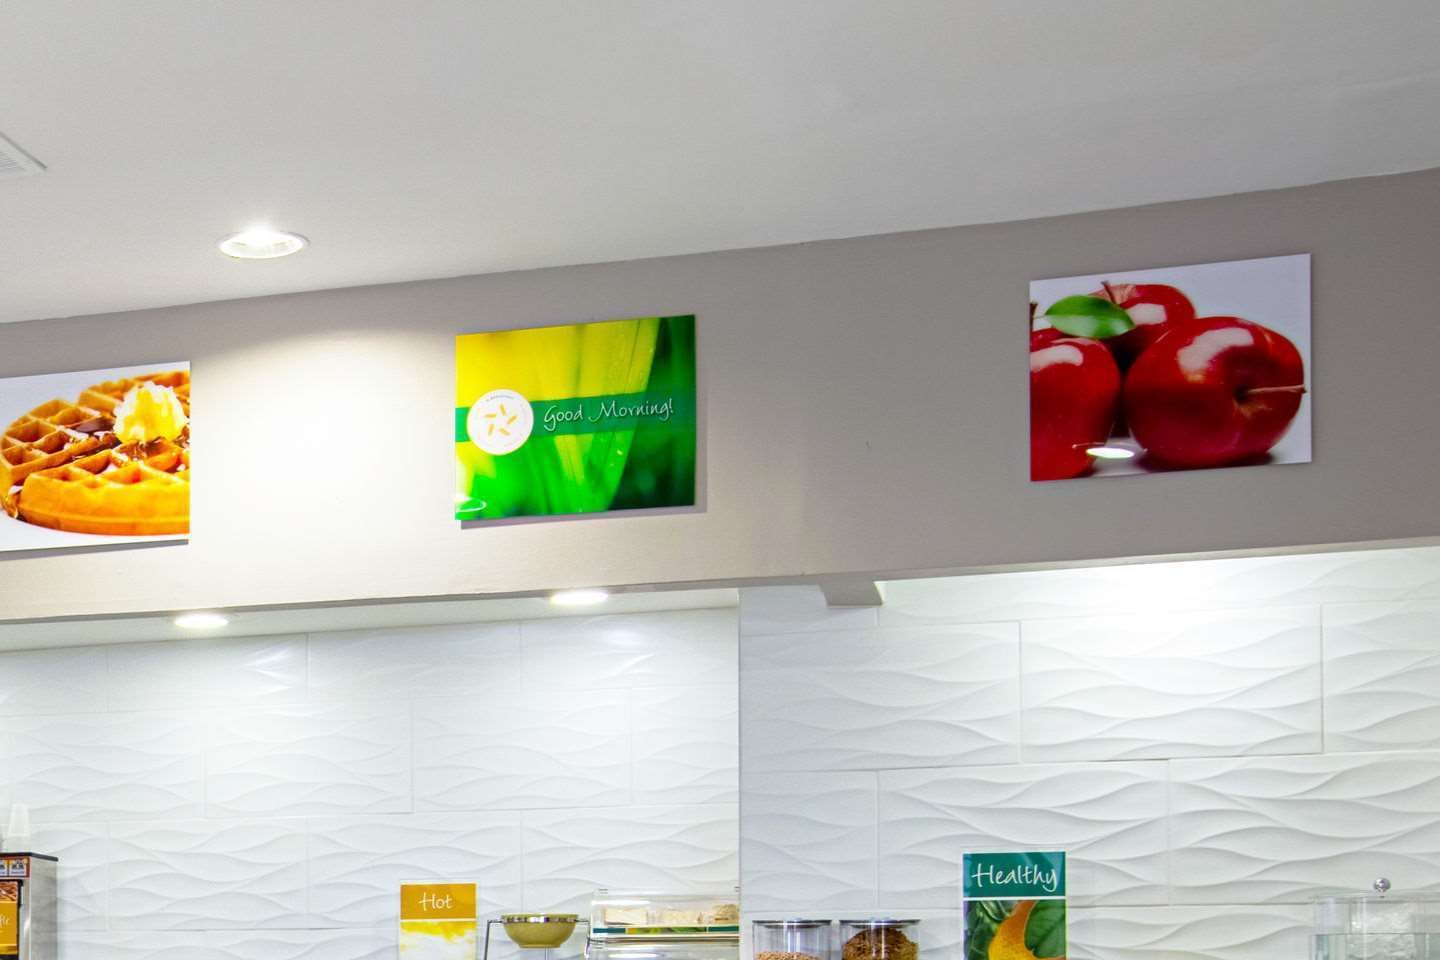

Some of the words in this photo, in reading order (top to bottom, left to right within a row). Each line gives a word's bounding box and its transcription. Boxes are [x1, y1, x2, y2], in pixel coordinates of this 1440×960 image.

[543, 403, 584, 432] Good
[588, 397, 674, 422] Morning!
[971, 863, 1058, 893] Healthy
[418, 891, 454, 911] Hot
